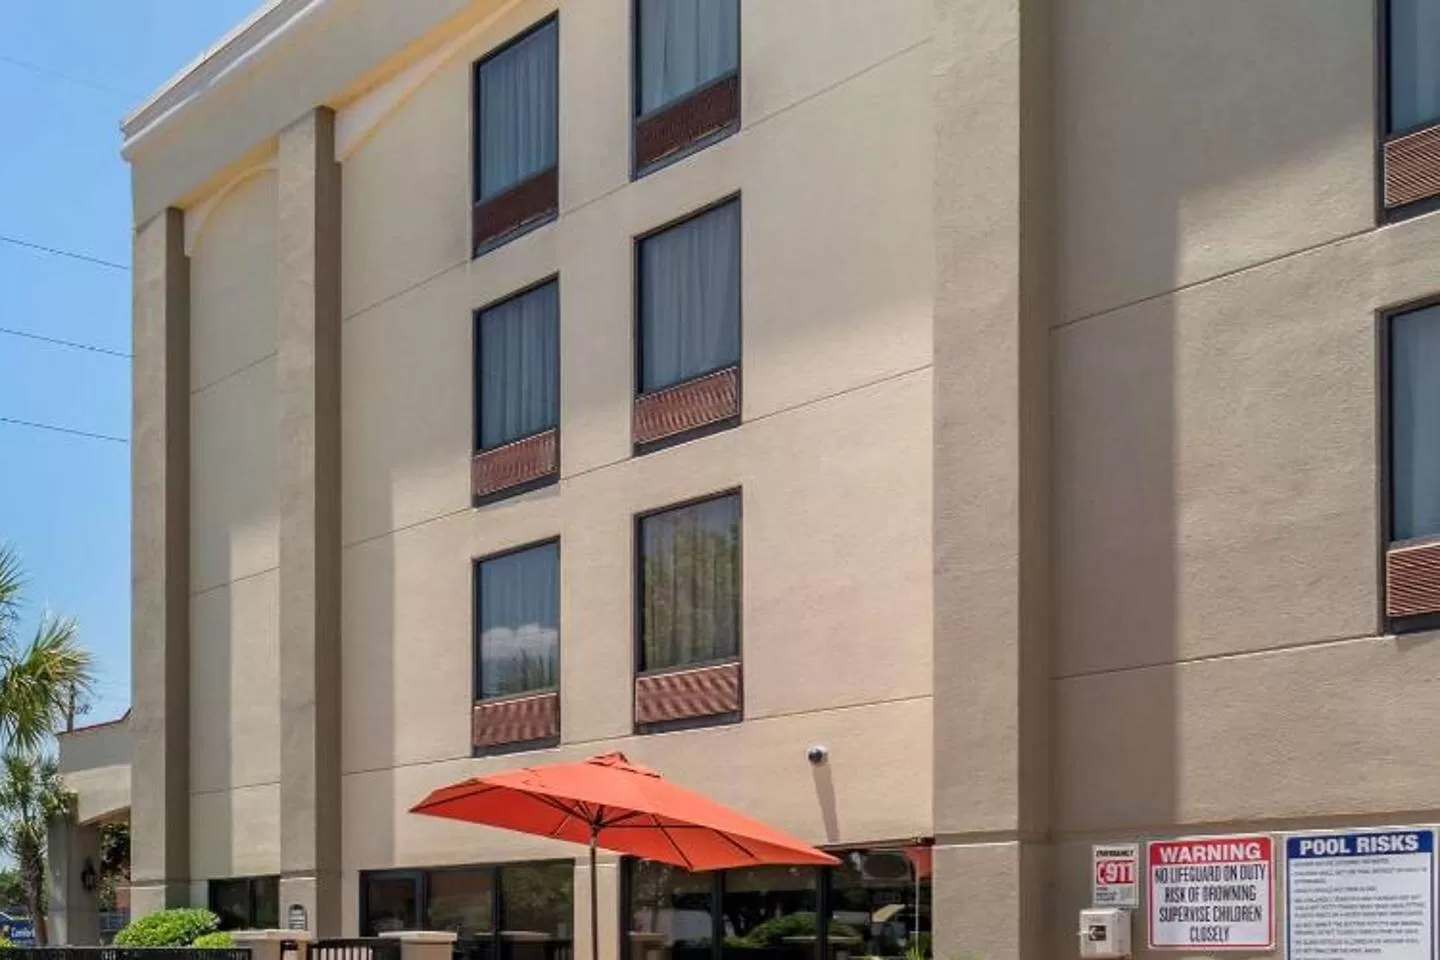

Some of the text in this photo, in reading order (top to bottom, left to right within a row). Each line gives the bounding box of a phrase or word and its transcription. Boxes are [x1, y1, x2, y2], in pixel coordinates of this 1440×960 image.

[1160, 842, 1262, 862] WARNING
[1299, 834, 1419, 855] POOL RISKS
[1155, 864, 1266, 884] NO LIFEGUARD ON DUTY
[1164, 884, 1257, 903] RISK OF DROWNING
[1159, 905, 1262, 922] SUPERVISE CHILDREN
[1189, 925, 1230, 942] CLOSELY
